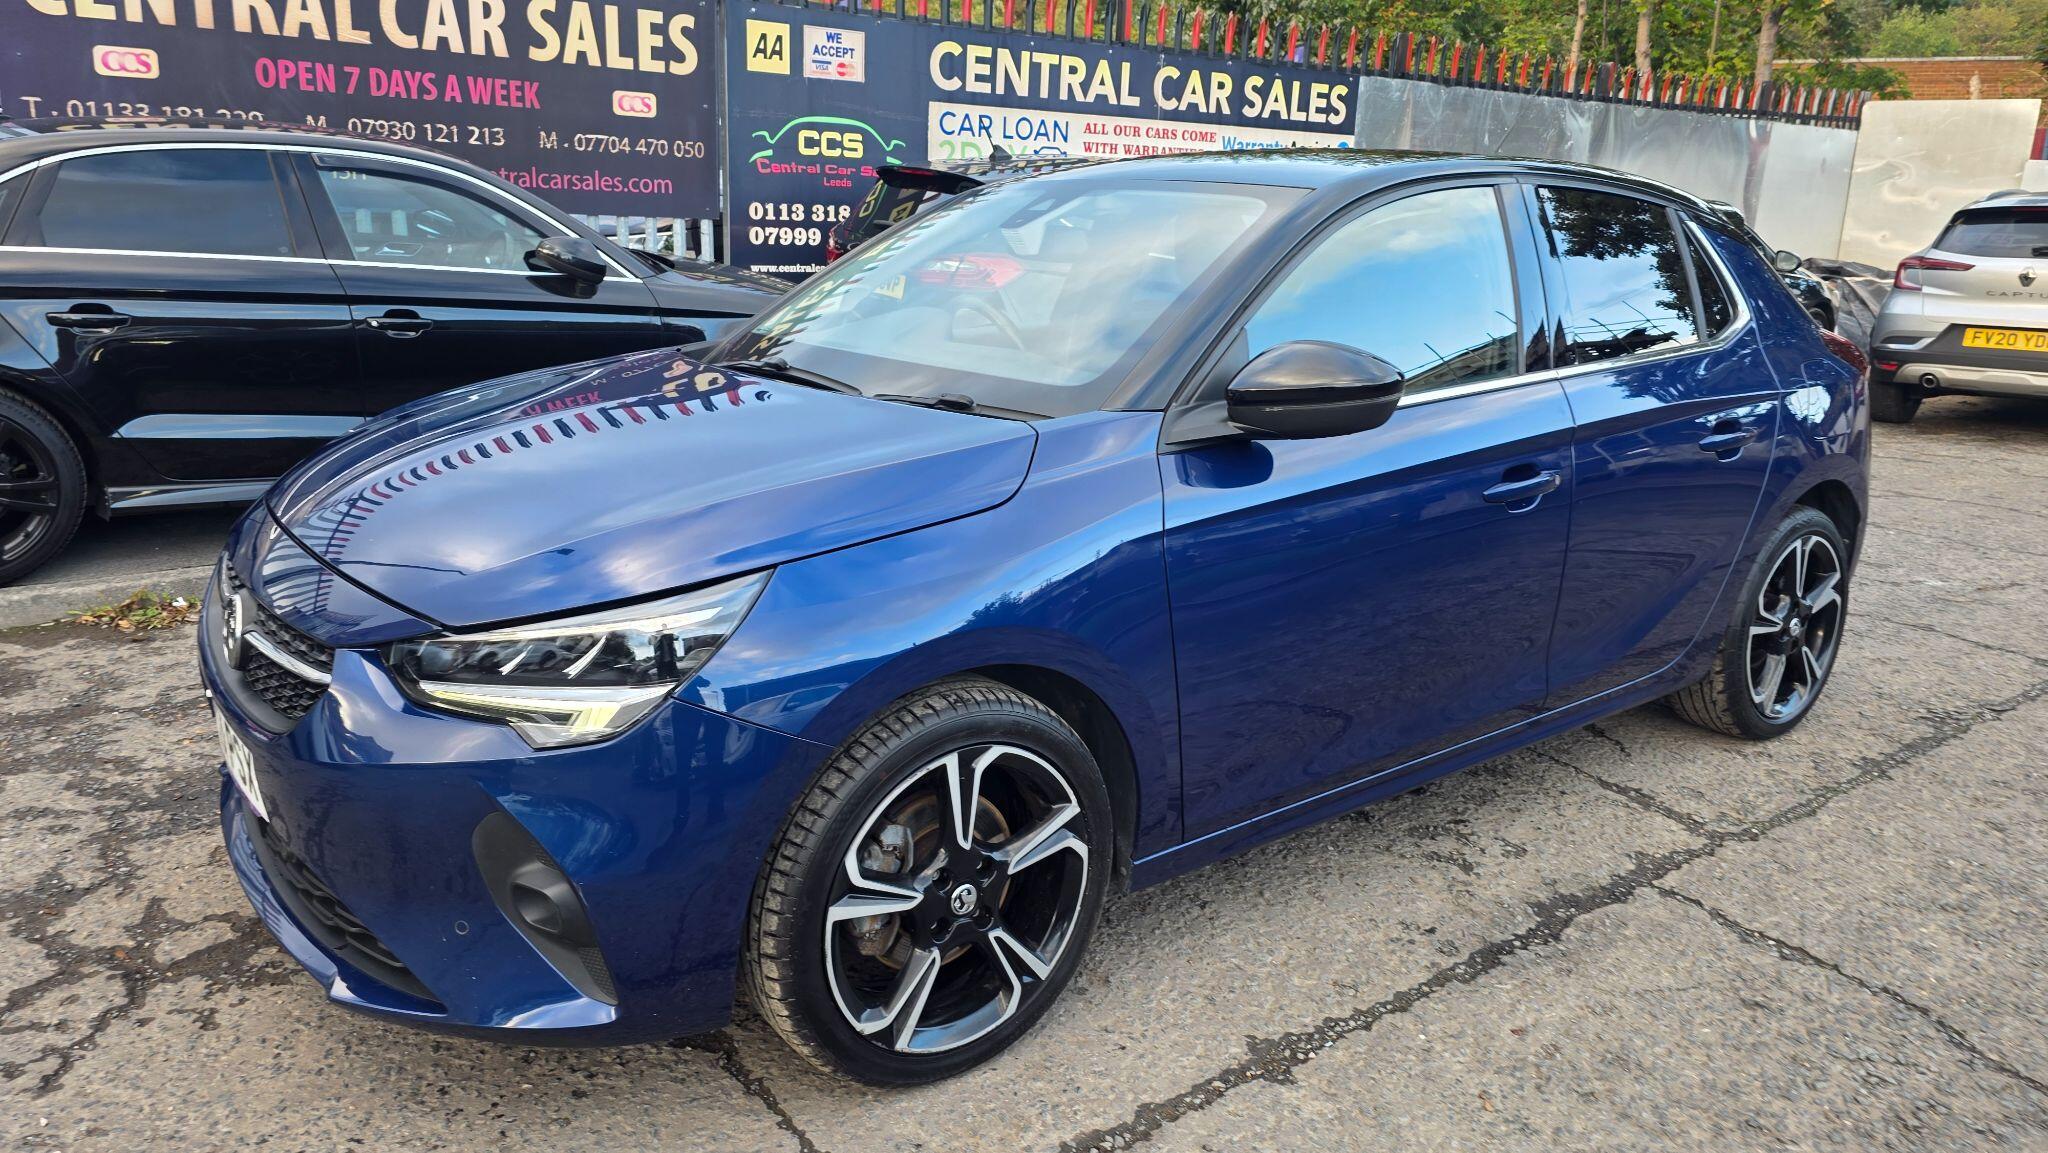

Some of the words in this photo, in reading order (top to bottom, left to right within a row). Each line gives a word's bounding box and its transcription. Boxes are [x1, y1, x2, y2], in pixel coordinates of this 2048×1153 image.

[379, 0, 509, 58] CAR
[527, 0, 698, 76] SALES
[752, 33, 783, 61] AA
[825, 32, 842, 44] WE
[813, 44, 855, 60] ACCEPT
[255, 57, 337, 94] OPEN
[343, 67, 360, 95] 7
[369, 67, 438, 101] DAYS
[444, 74, 463, 103] A
[467, 75, 541, 110] WEEK
[930, 41, 1140, 107] CENTRAL
[1153, 66, 1233, 115] CAR
[1241, 76, 1349, 125] SALES
[348, 117, 416, 140] 07930
[423, 123, 458, 143] 121
[467, 126, 506, 146] 213
[940, 111, 993, 138] CAR
[1003, 115, 1069, 143] LOAN
[1083, 122, 1108, 135] ALL
[1113, 125, 1141, 138] OUR
[1145, 127, 1178, 140] CARS
[1182, 130, 1217, 143] COME
[574, 134, 629, 154] 07704
[635, 138, 668, 157] 470
[673, 141, 705, 158] 050
[798, 130, 864, 158] CCS
[1083, 142, 1119, 155] WITH
[1123, 144, 1204, 158] WARRAN
[756, 157, 821, 175] Central
[825, 164, 857, 176] Car
[491, 166, 673, 195] tralcarsales.com
[823, 177, 852, 188] Leeds
[749, 201, 805, 222] 0113
[812, 204, 851, 222] 318
[749, 227, 822, 246] 07999
[1971, 331, 2018, 345] FV20
[2024, 333, 2048, 349] YD
